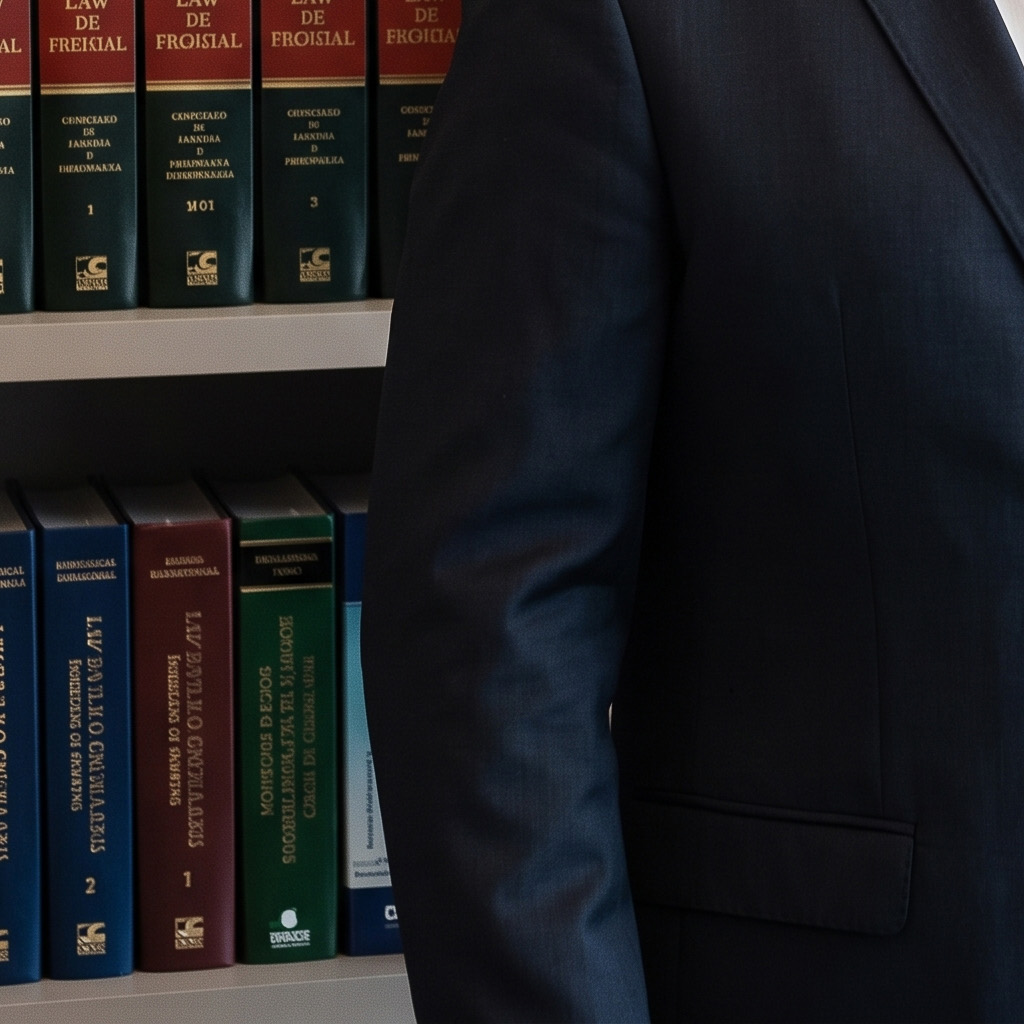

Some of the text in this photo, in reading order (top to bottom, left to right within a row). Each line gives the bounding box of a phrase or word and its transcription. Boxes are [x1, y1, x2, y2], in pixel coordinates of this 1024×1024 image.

[186, 12, 211, 28] DE
[301, 10, 325, 25] DE
[414, 7, 439, 22] DE
[75, 14, 100, 31] DE
[87, 204, 94, 215] 1
[309, 196, 318, 208] 3
[84, 876, 96, 895] 2
[183, 870, 192, 888] 1
